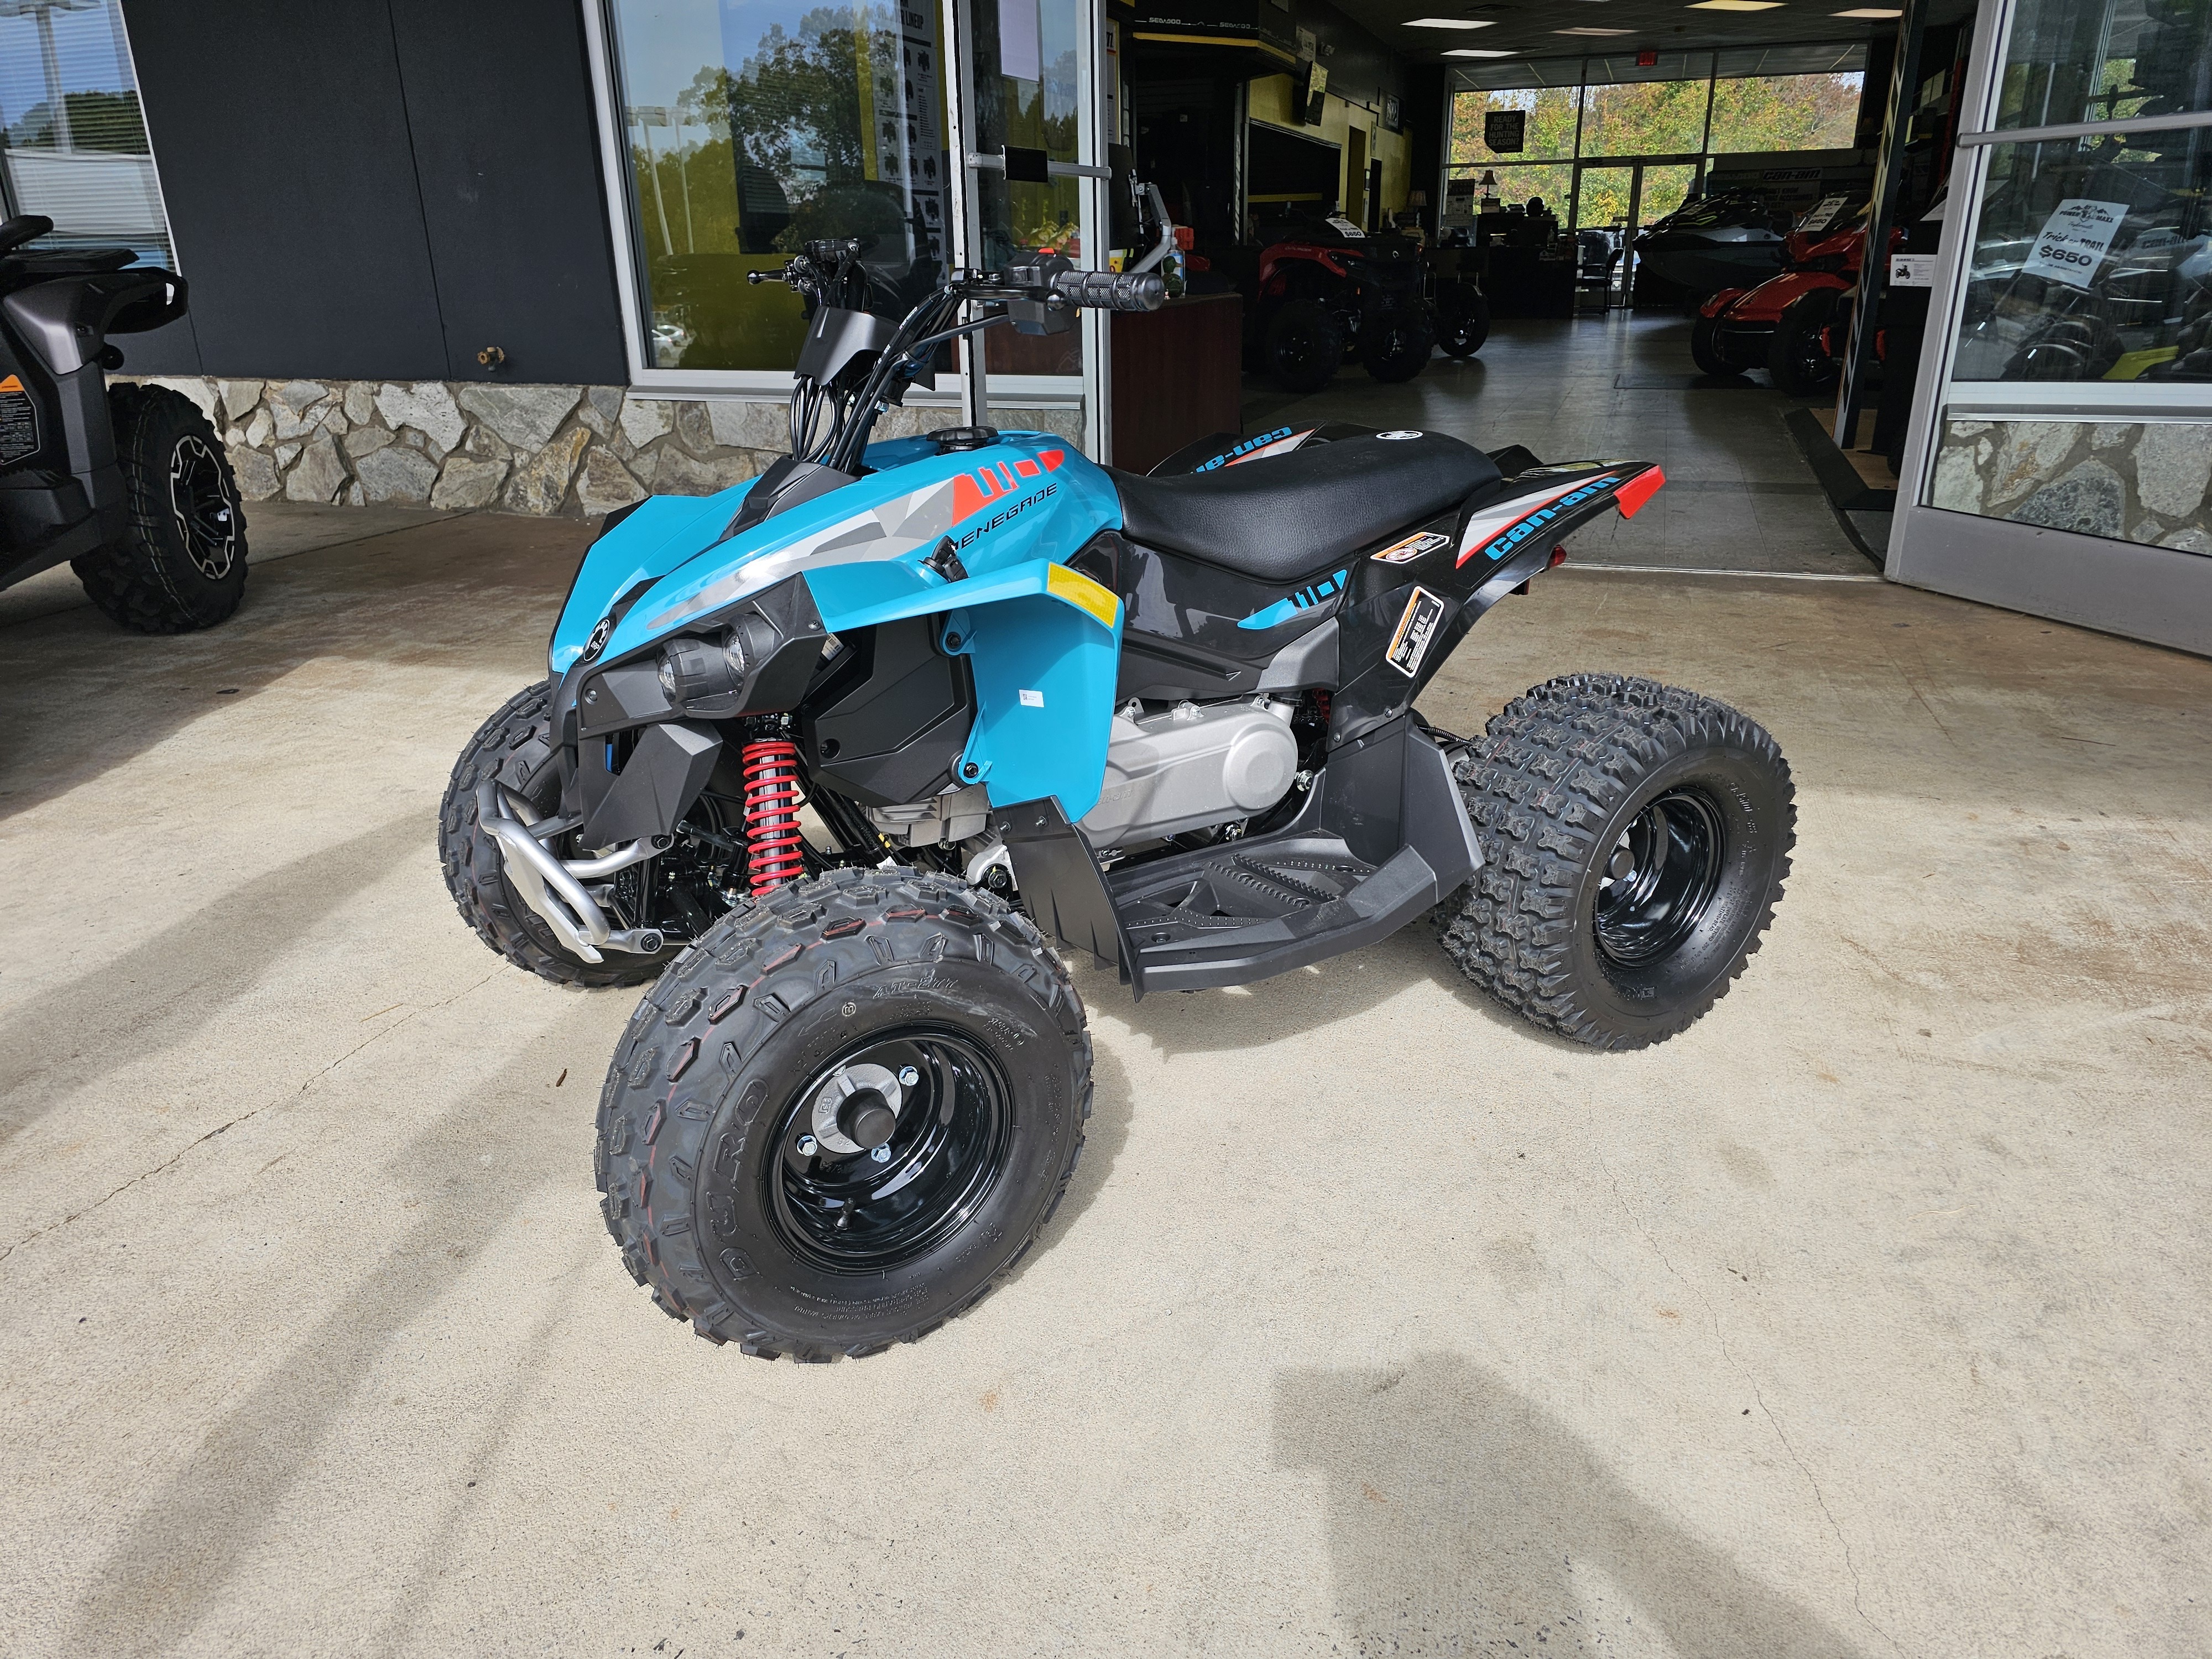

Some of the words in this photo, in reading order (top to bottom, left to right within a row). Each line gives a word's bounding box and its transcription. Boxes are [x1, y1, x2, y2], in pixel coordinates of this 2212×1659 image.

[906, 11, 924, 30] LINEUP
[1494, 114, 1517, 123] READY
[1488, 138, 1520, 146] SEASON?
[2042, 232, 2069, 242] Trick
[2080, 238, 2105, 252] TRAIL
[2038, 244, 2093, 267] $650
[1190, 426, 1293, 474] can-a
[1484, 477, 1621, 560] can-am
[590, 640, 601, 651] BRP
[1708, 924, 1721, 943] BEYOND
[707, 1078, 770, 1281] DURO
